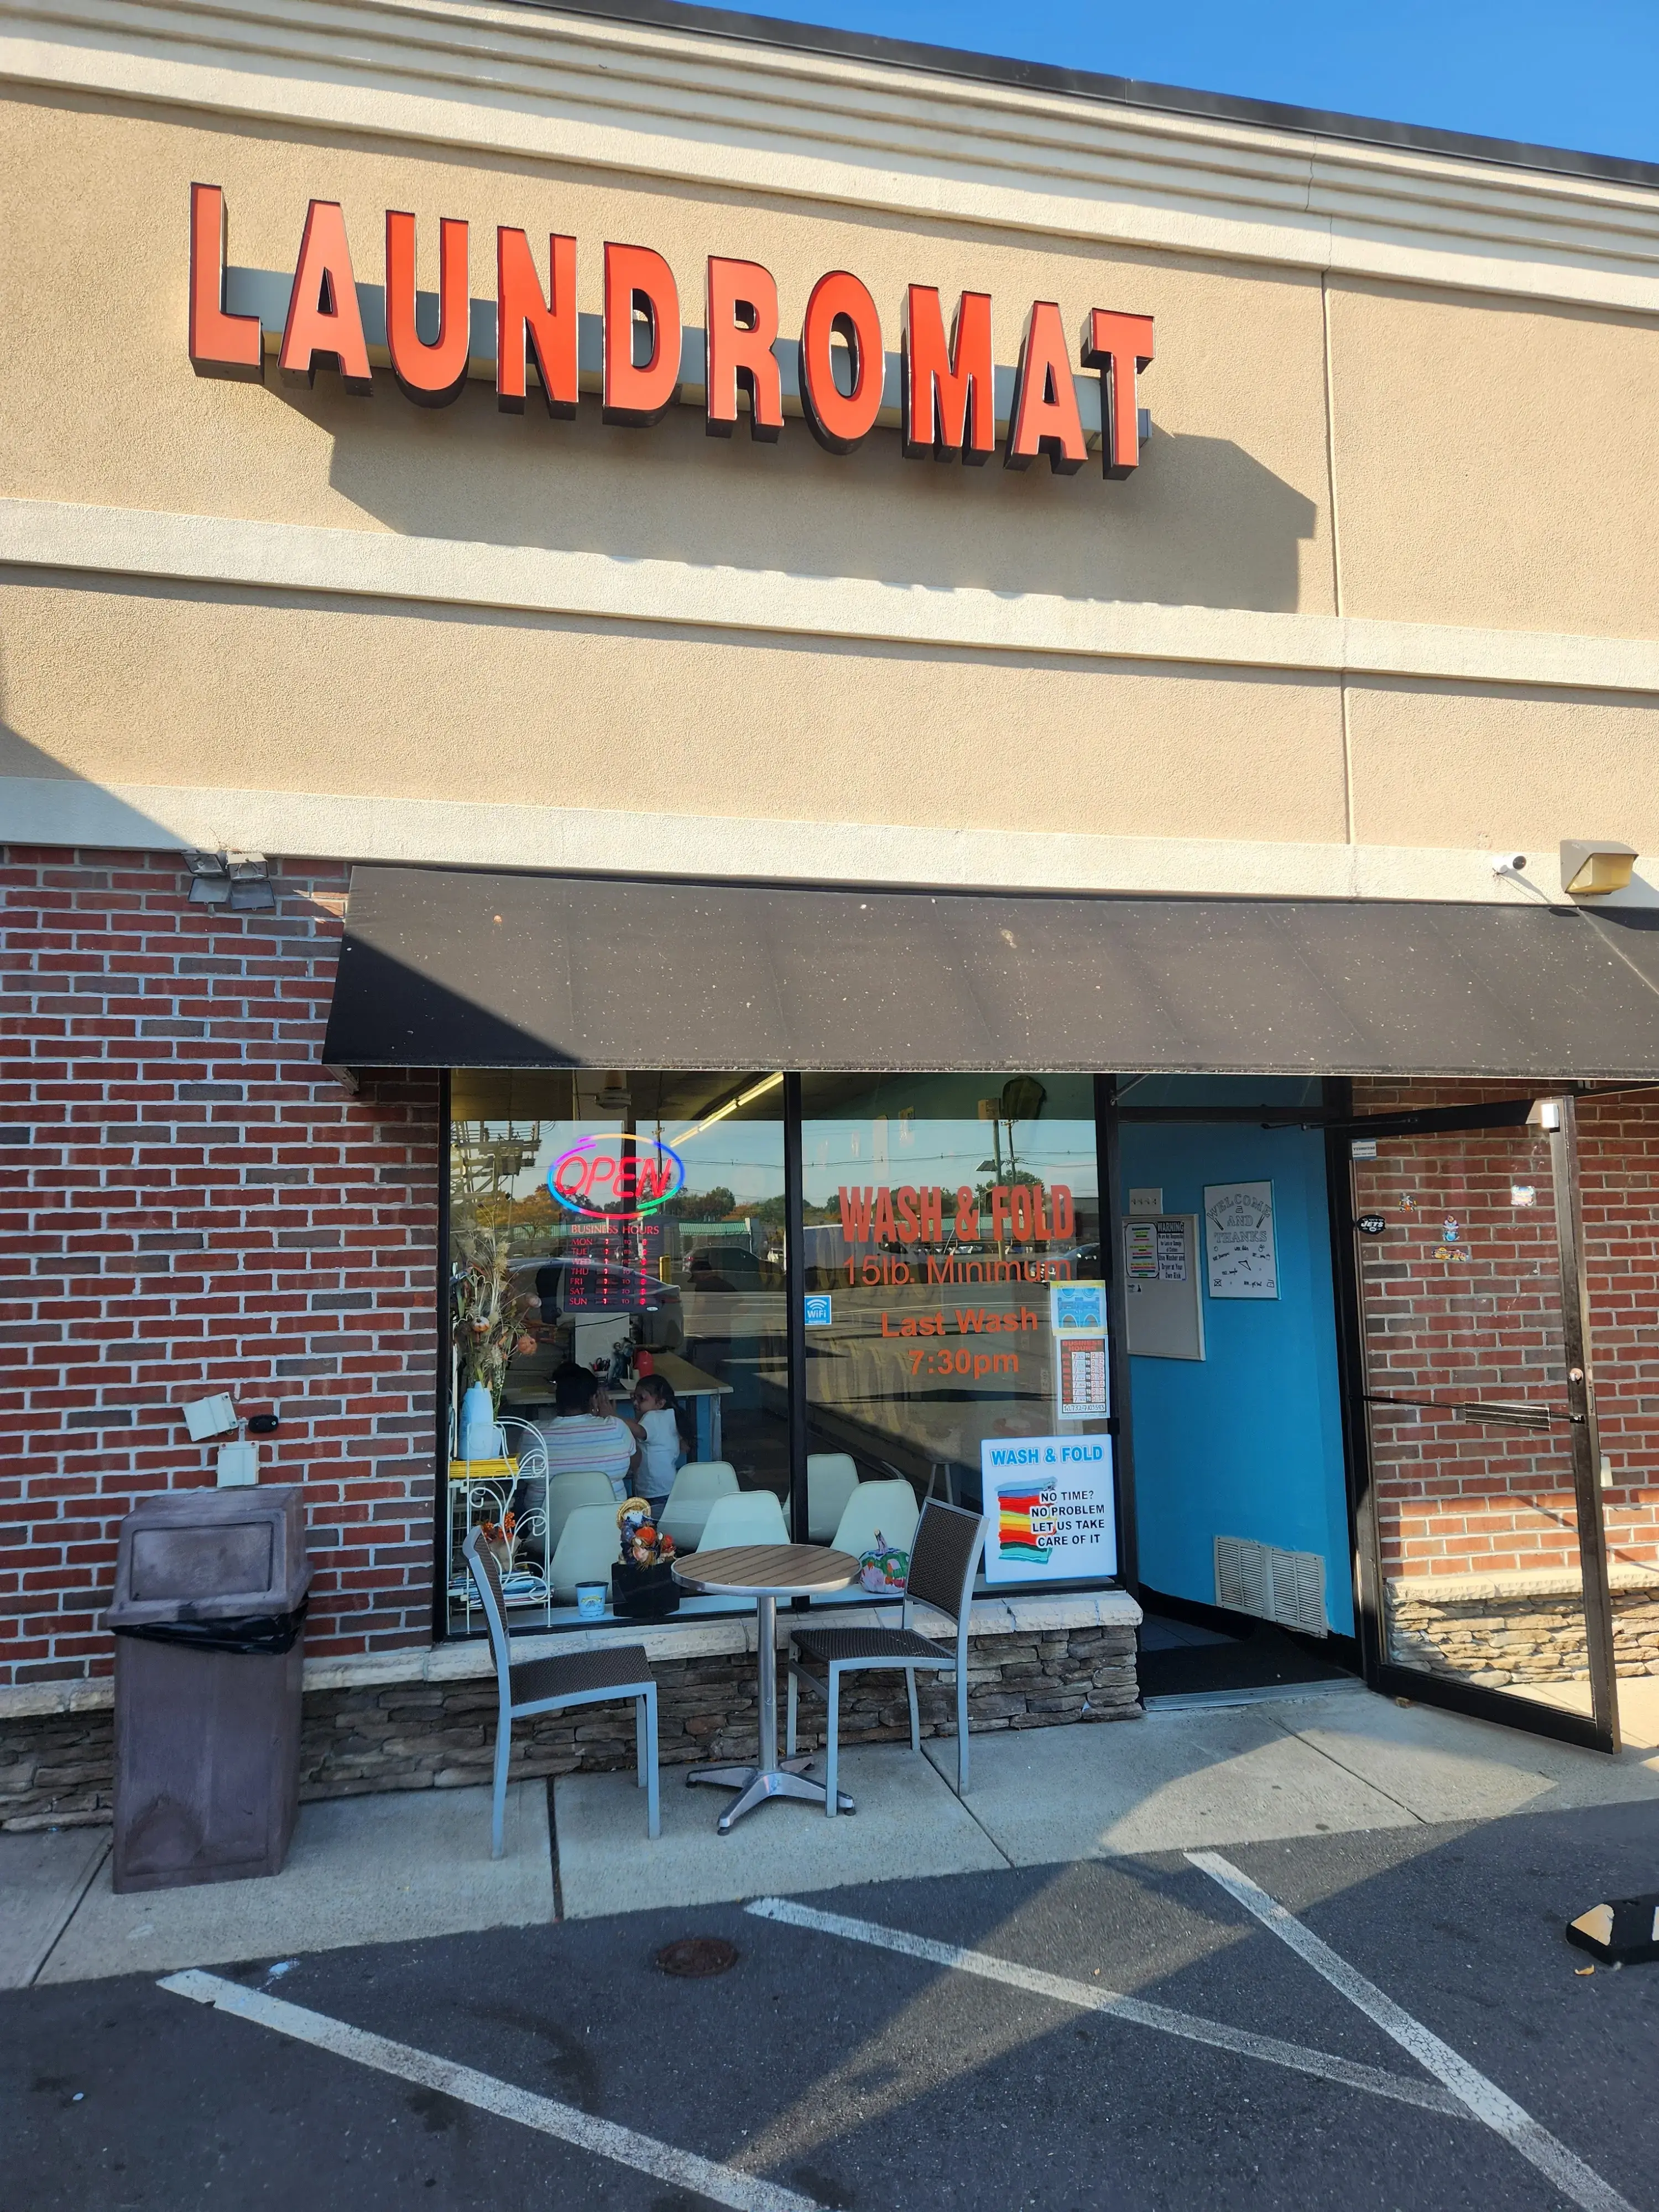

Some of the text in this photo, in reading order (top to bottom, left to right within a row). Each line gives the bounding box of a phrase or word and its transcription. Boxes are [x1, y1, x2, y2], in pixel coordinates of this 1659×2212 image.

[189, 182, 1155, 474] LAUNDROMAT
[555, 1155, 672, 1198] OPEN
[1206, 1193, 1272, 1219] WELCOME
[838, 1185, 1074, 1243] WASH & FOLD
[1158, 1222, 1184, 1232] WARNING
[1227, 1215, 1253, 1227] AND
[571, 1225, 660, 1235] BUSINESS HOURS
[1214, 1231, 1267, 1243] THANKS
[843, 1255, 1072, 1285] 15lb. Minimum
[807, 1310, 826, 1318] WiFi
[881, 1306, 1037, 1337] Last Wash
[908, 1348, 1019, 1380] 7:30pm
[990, 1446, 1103, 1465] WASH & FOLD
[1041, 1490, 1094, 1502] NO TIME?
[1031, 1505, 1104, 1517] NO PROBLEM
[1032, 1520, 1105, 1532] LET US TAKE
[1038, 1535, 1100, 1547] CARE OF IT
